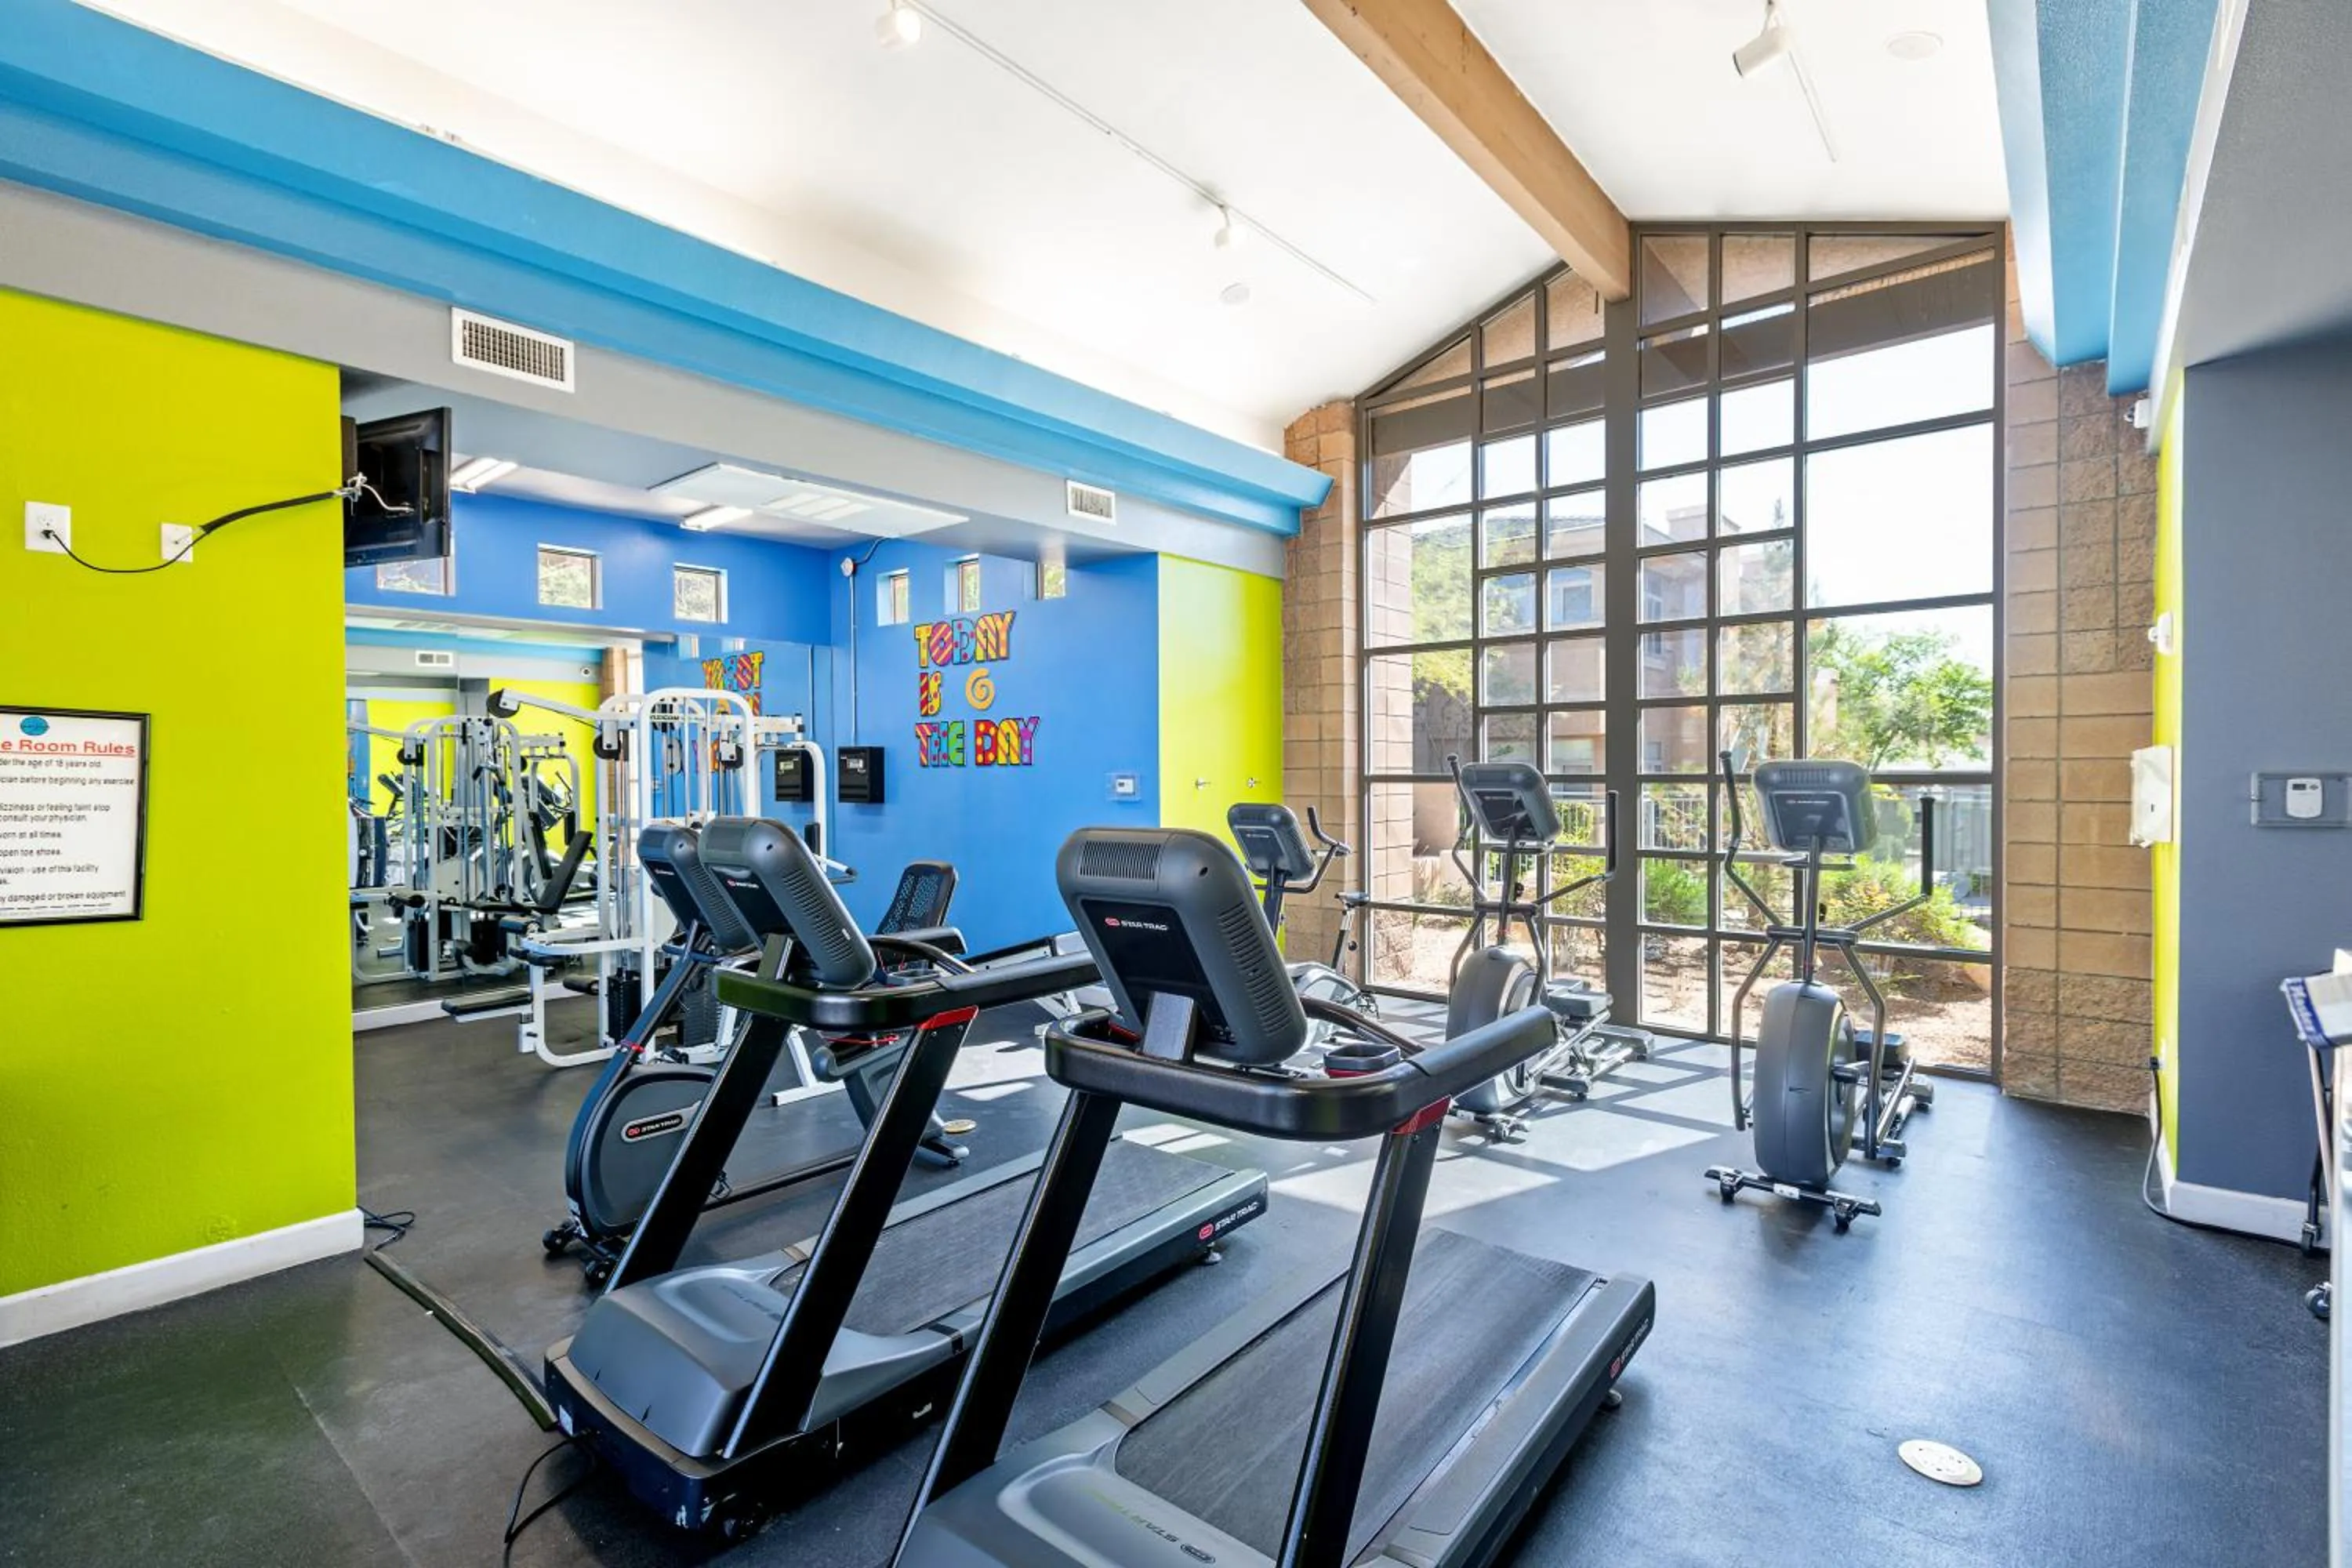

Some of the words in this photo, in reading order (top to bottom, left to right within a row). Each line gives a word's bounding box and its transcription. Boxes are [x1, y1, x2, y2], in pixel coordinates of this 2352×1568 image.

[913, 610, 1017, 668] TODAY
[920, 670, 942, 717] IS
[19, 739, 77, 752] Room
[83, 740, 136, 754] Rules
[915, 719, 966, 768] THE
[974, 716, 1040, 766] DAY
[27, 760, 42, 769] age
[65, 760, 87, 770] years
[49, 777, 86, 786] beginning
[46, 803, 72, 812] feeling
[74, 803, 93, 811] faint
[93, 804, 111, 812] stop
[30, 815, 48, 824] your
[74, 863, 99, 873] facility
[8, 892, 48, 903] damaged
[57, 891, 85, 901] broken
[86, 890, 126, 900] equipment
